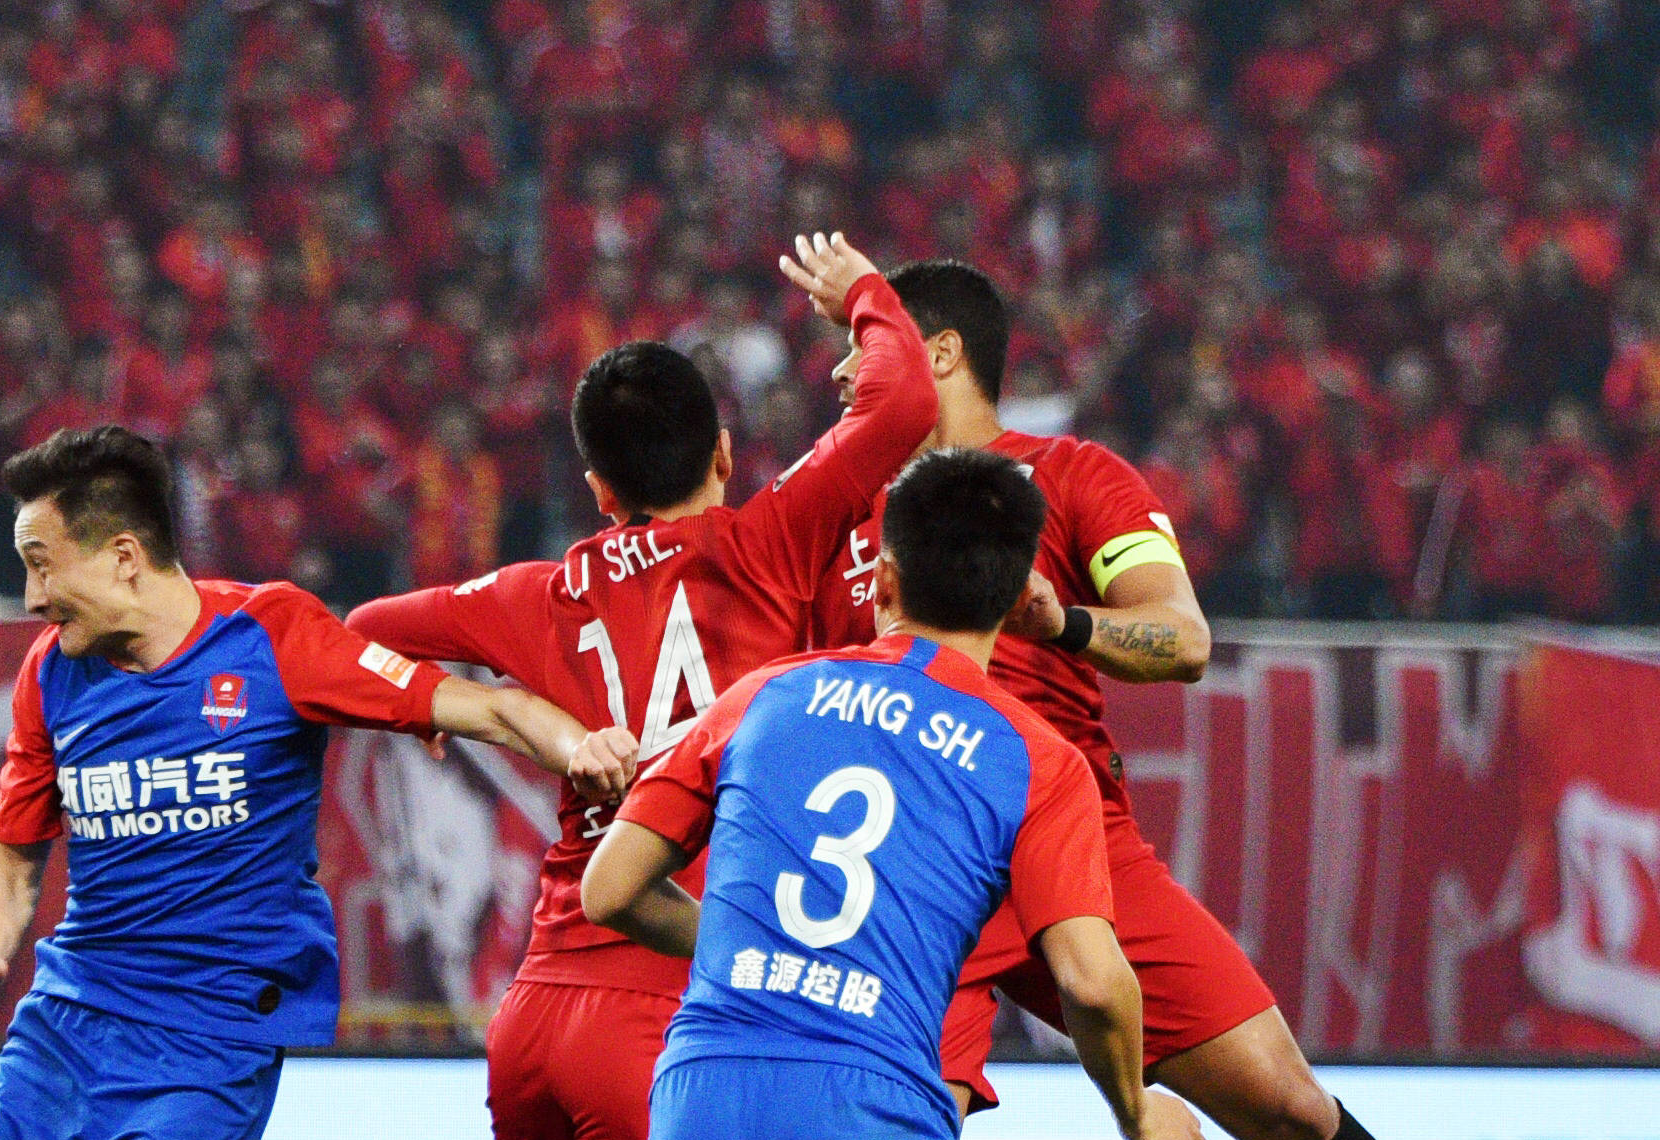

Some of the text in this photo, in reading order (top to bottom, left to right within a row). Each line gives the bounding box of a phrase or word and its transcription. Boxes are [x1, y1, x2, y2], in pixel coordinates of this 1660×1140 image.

[602, 530, 682, 583] SH.L.
[578, 580, 718, 762] 14
[804, 678, 984, 771] YANG SH.
[111, 800, 249, 838] MOTORS
[774, 765, 897, 949] 3
[730, 947, 882, 1019] 鑫源控股
